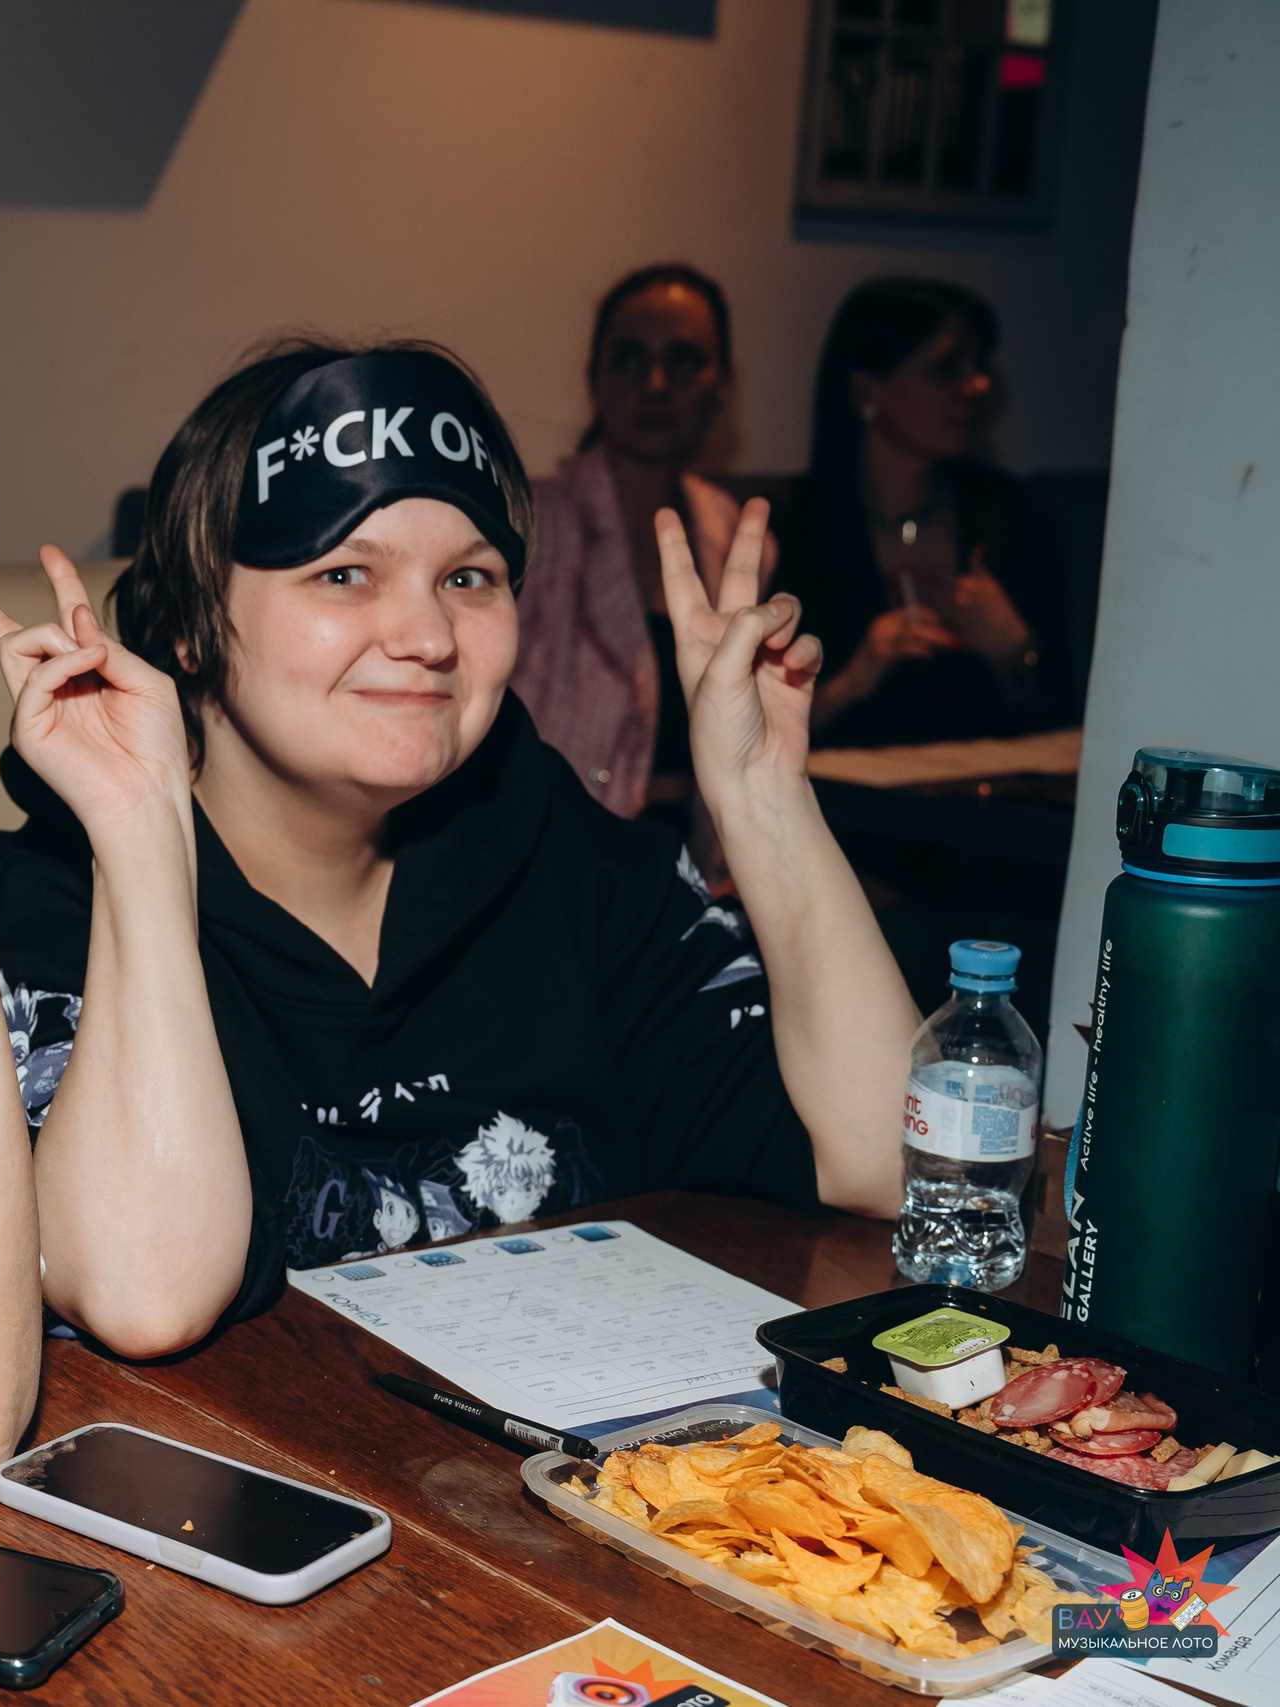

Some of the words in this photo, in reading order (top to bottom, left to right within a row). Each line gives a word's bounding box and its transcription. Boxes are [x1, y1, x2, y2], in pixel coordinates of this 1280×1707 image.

[1101, 938, 1113, 972] life
[1092, 977, 1111, 1052] healthy
[1087, 1071, 1098, 1103] life
[1080, 1106, 1094, 1171] Active
[1077, 1219, 1098, 1322] GALLERY
[433, 1393, 453, 1406] Bruno
[454, 1399, 482, 1416] Visconti
[1204, 1635, 1252, 1672] Команда
